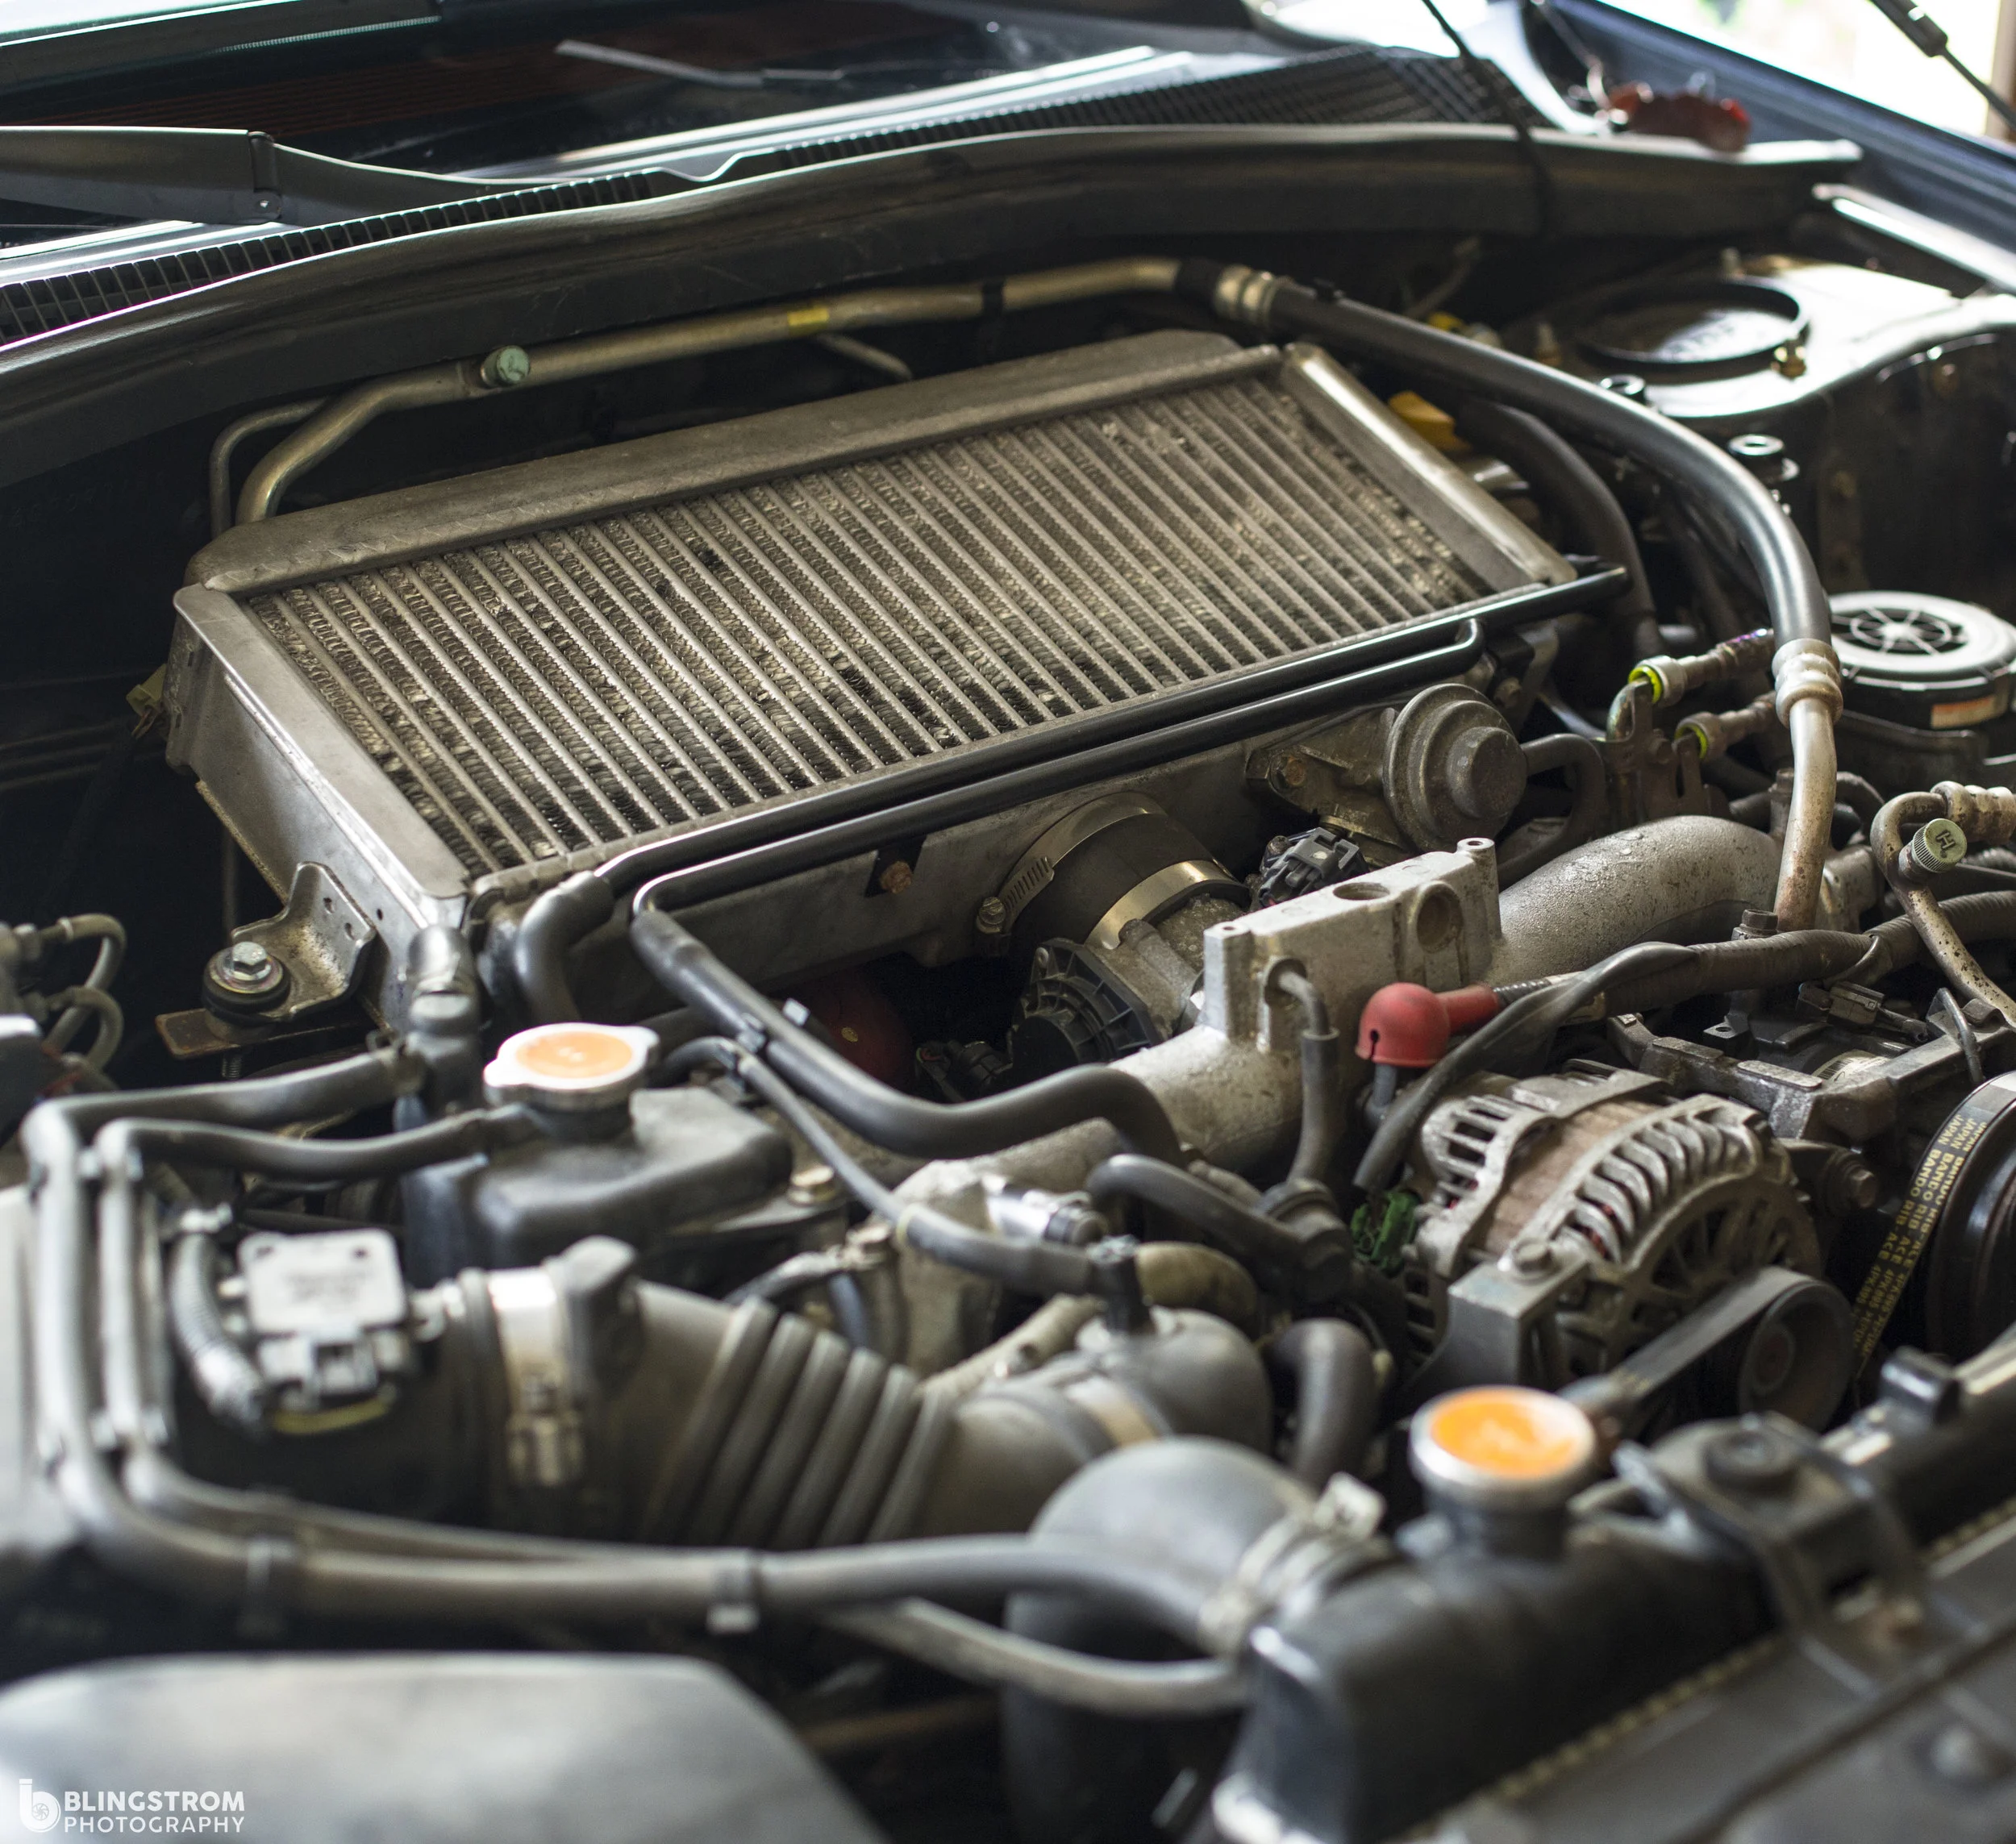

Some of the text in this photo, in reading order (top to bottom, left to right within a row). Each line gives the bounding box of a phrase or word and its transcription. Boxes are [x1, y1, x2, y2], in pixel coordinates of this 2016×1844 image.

[1935, 830, 1956, 850] H
[1938, 1114, 1964, 1145] JAPAN
[1951, 1118, 1977, 1149] JAPAN
[1910, 1149, 1942, 1197] BANDO
[1922, 1152, 1955, 1201] BANDO
[1896, 1199, 1915, 1225] RIB
[1908, 1204, 1927, 1230] RIB
[1878, 1232, 1897, 1259] ACE
[1890, 1236, 1910, 1264] ACE
